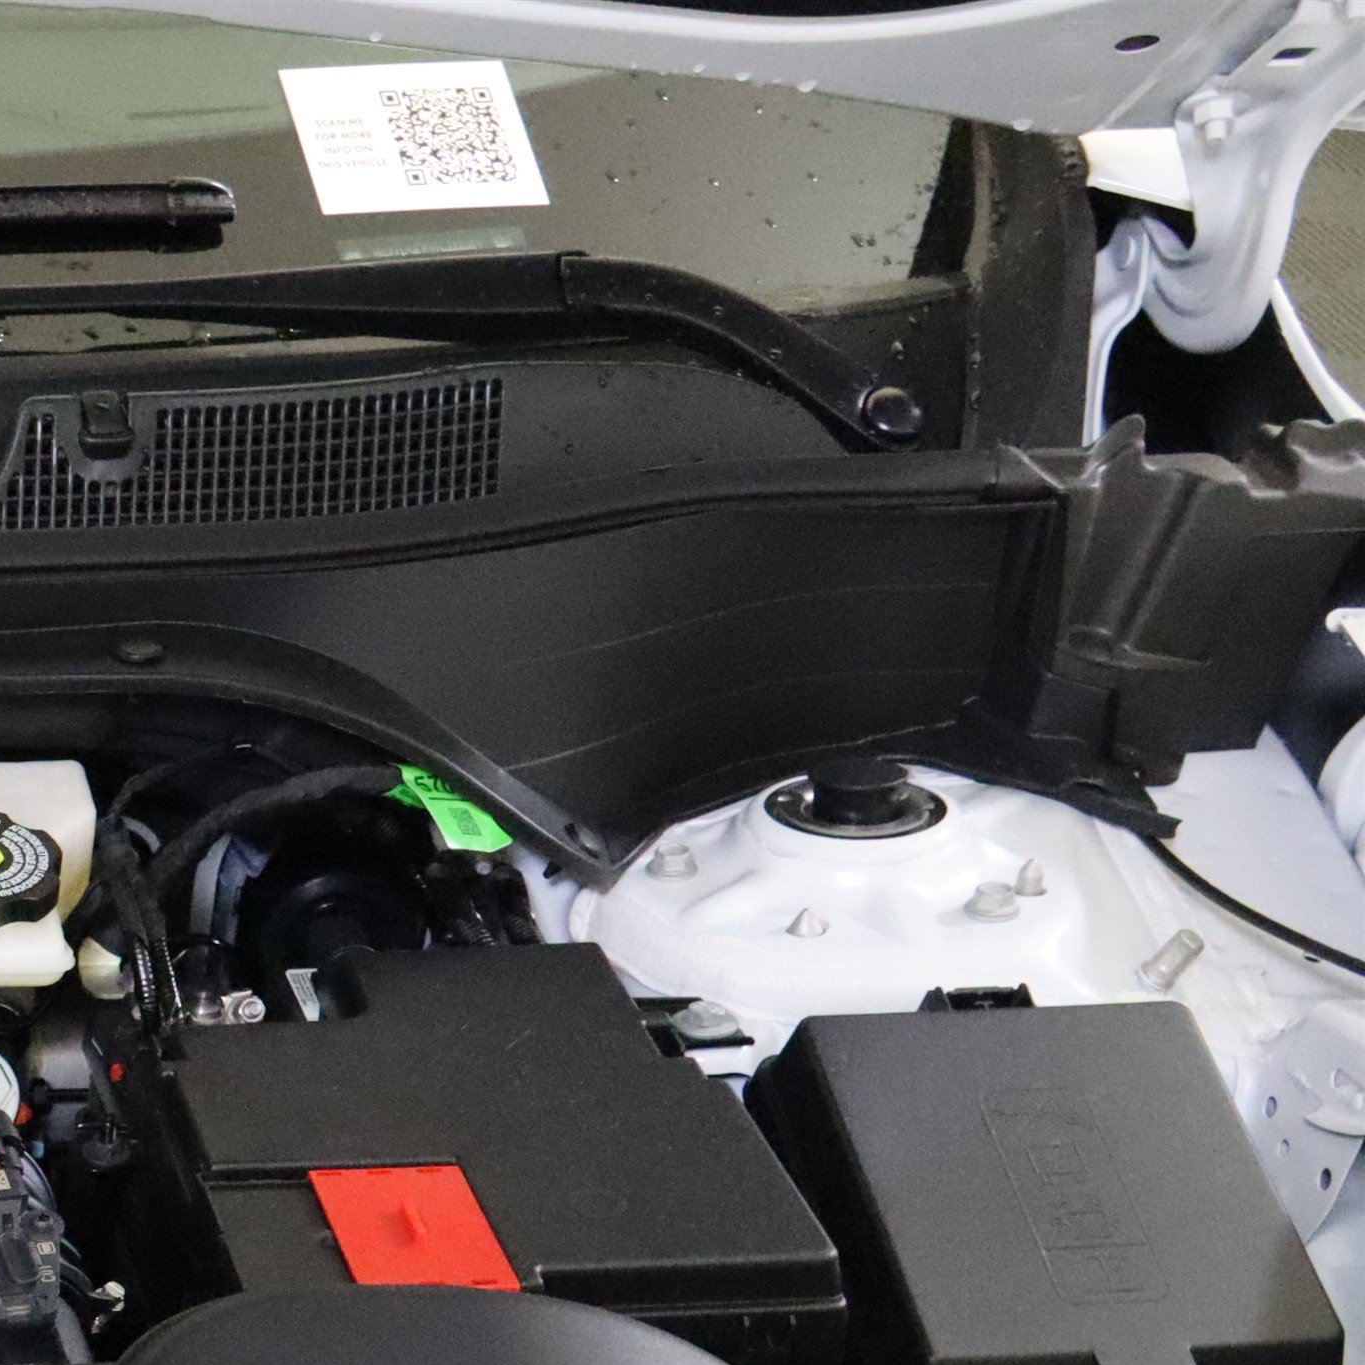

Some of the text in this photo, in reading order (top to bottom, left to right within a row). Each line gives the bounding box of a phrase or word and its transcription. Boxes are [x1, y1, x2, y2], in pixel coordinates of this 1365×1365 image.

[315, 118, 364, 128] SCAN ME
[315, 131, 372, 141] FOR MORE
[324, 145, 373, 154] INFO ON
[318, 158, 388, 169] THIS VEHICLE
